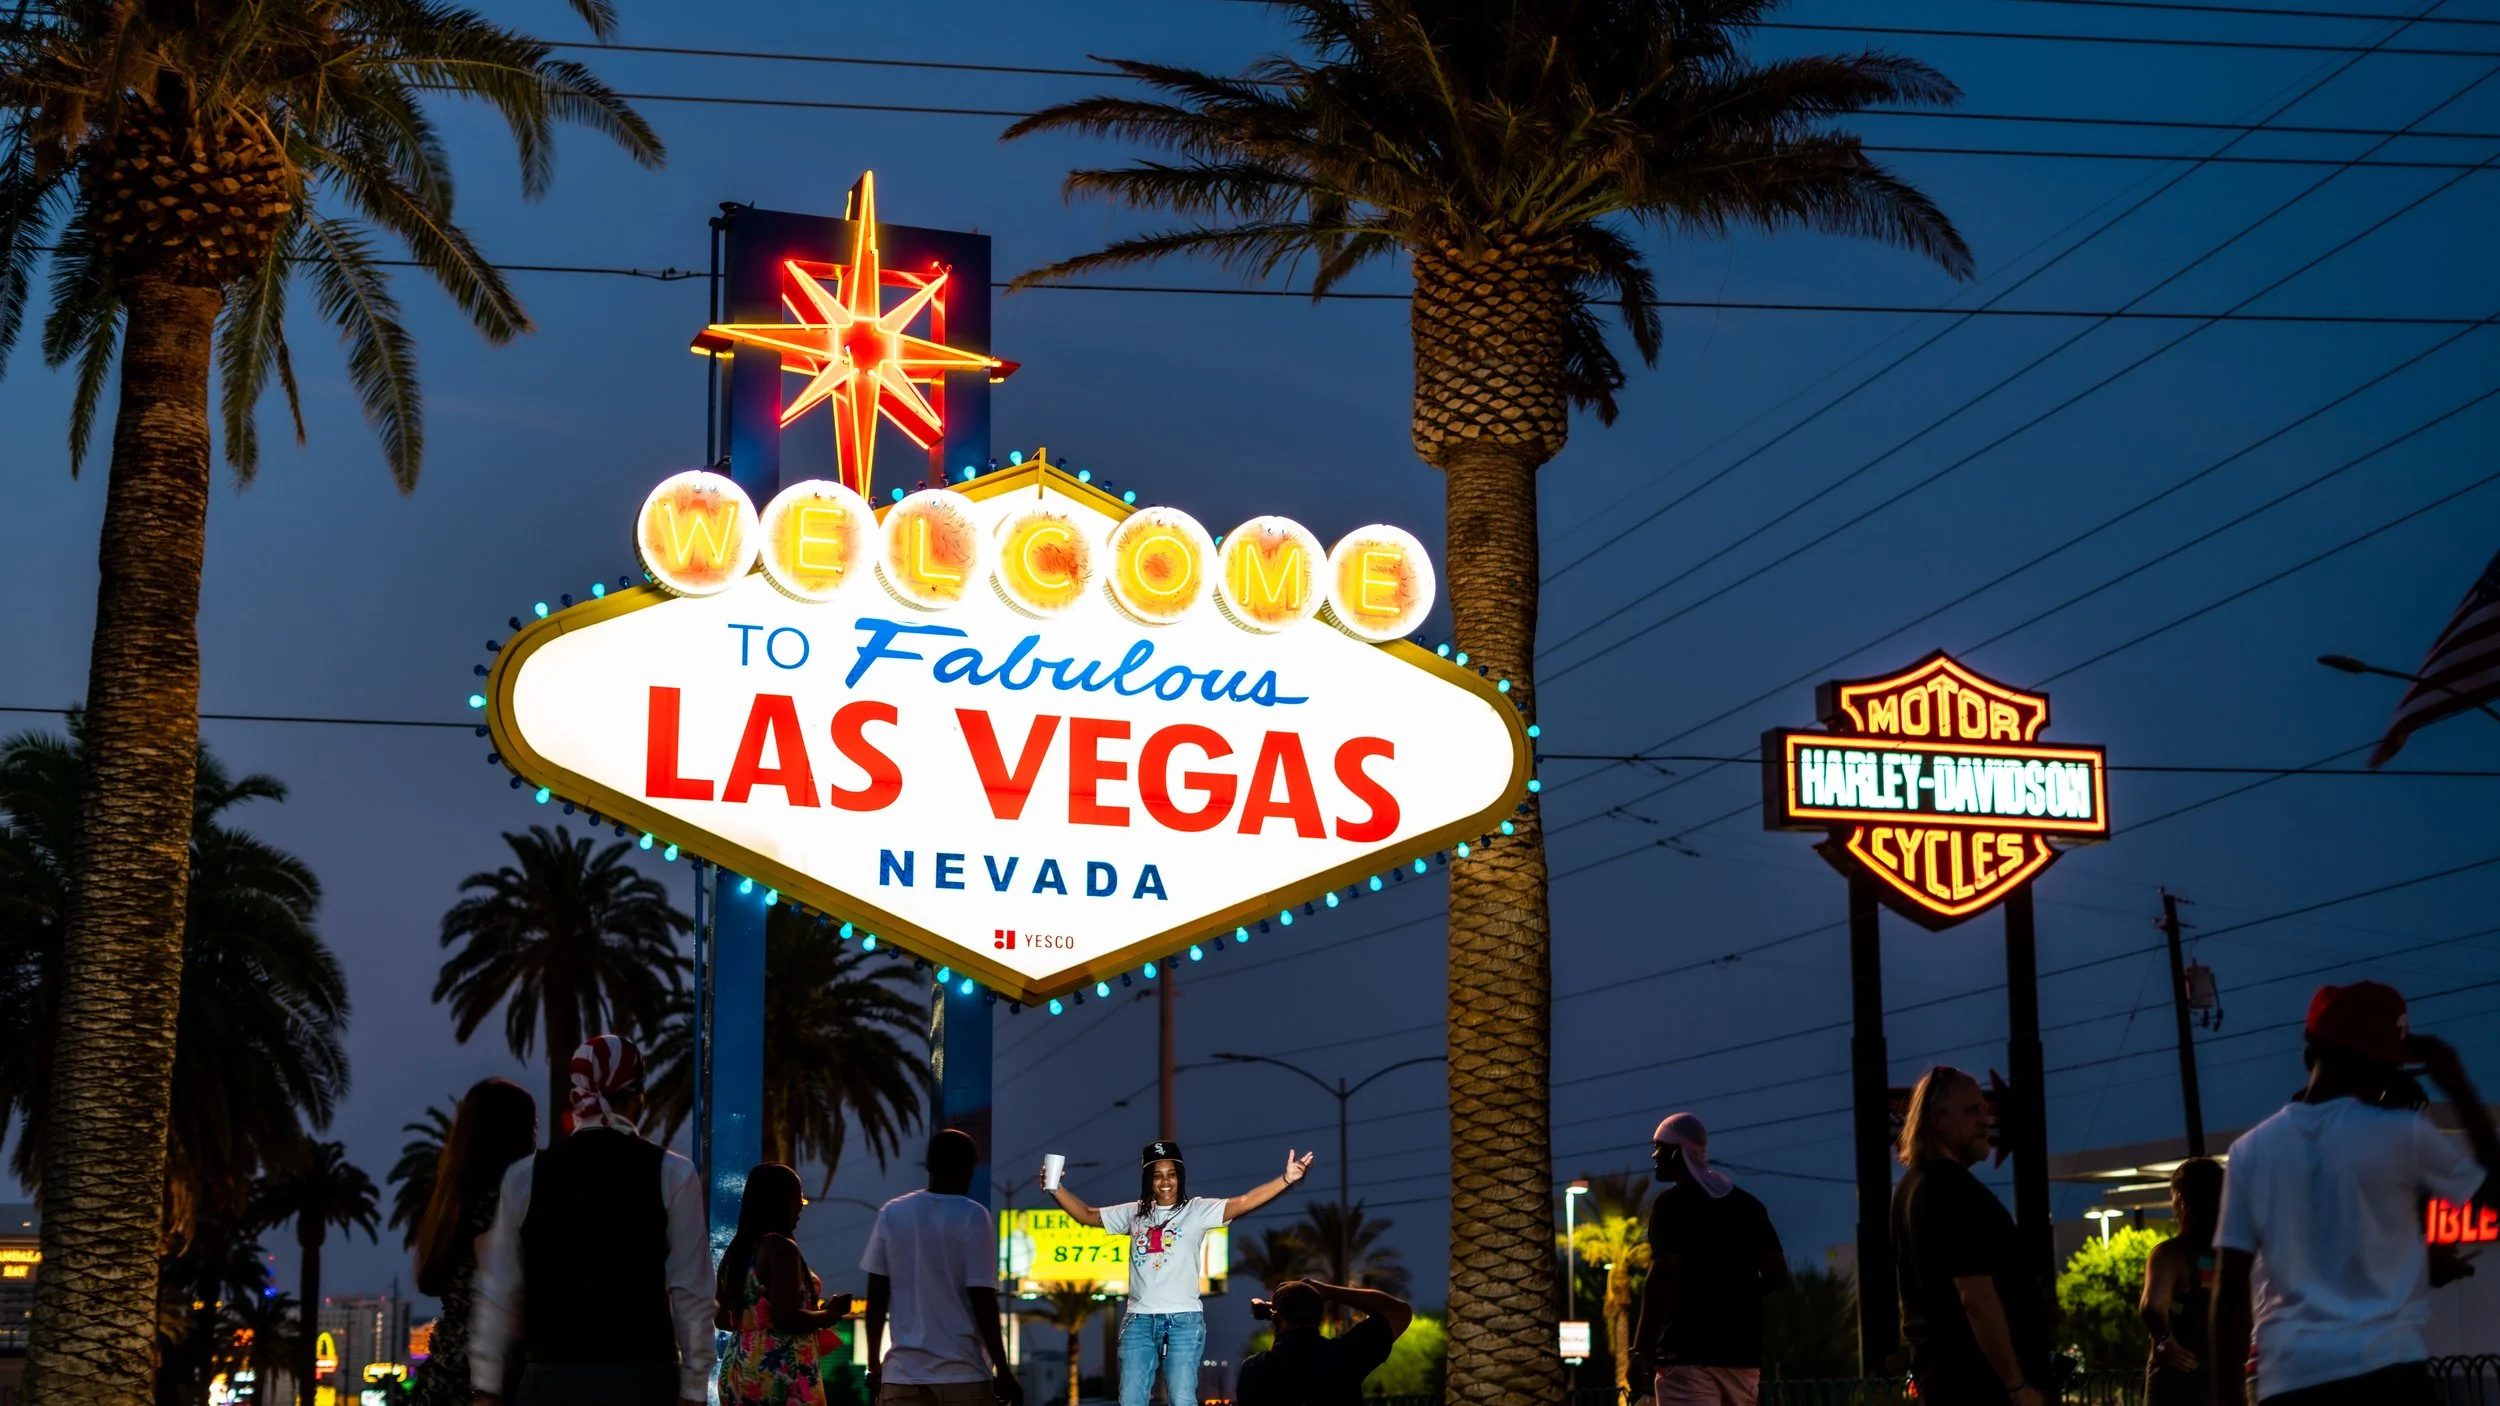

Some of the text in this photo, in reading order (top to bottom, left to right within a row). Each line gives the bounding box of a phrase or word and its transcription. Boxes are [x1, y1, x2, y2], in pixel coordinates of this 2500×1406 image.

[653, 500, 1403, 614] WELCOME
[727, 617, 1310, 707] TO Fabulous
[1867, 673, 2021, 742] MOTOR
[645, 686, 1402, 843] LAS VEGAS
[1800, 748, 2092, 819] HARLEY-DAVIDSON
[878, 848, 1169, 902] NEVADA
[1871, 826, 2025, 901] CYCLES
[1025, 934, 1074, 949] YESCO
[1054, 1245, 1123, 1262] 877-1
